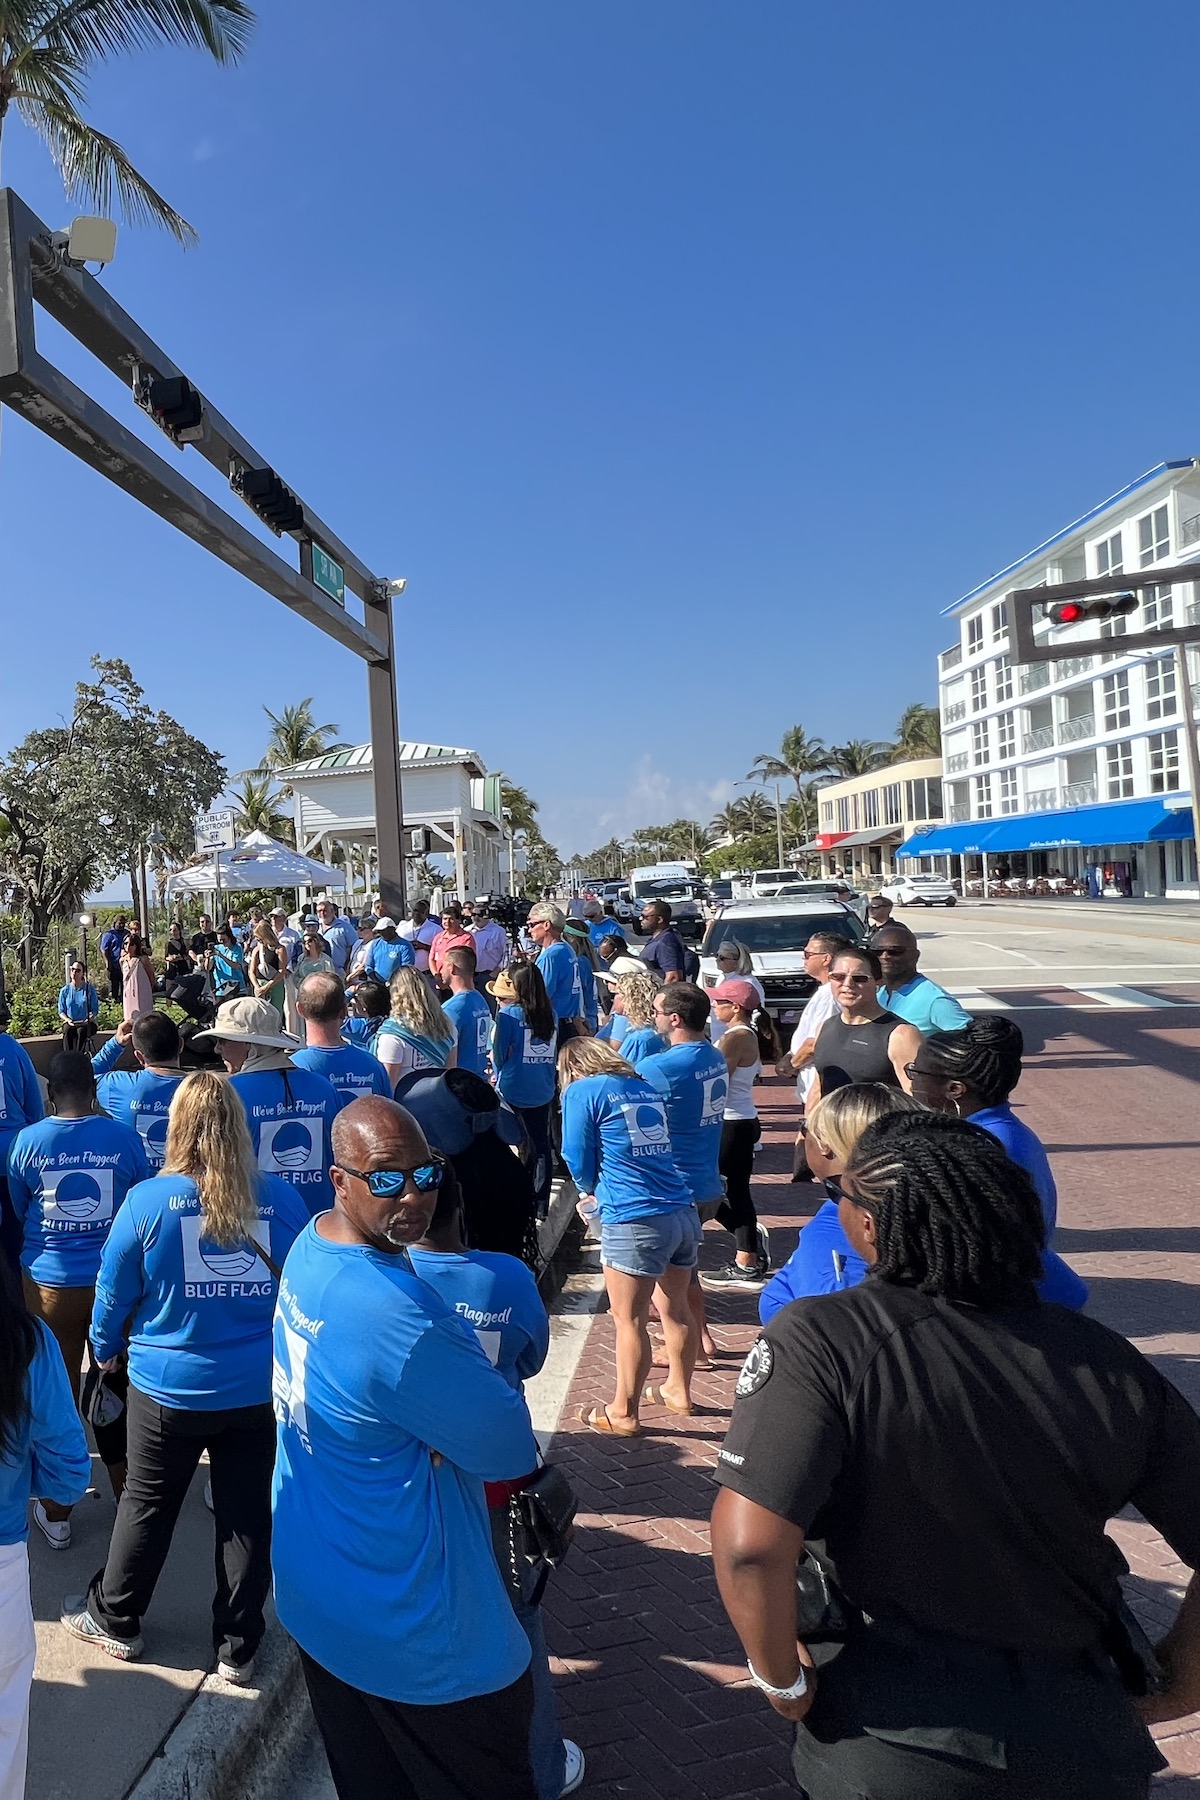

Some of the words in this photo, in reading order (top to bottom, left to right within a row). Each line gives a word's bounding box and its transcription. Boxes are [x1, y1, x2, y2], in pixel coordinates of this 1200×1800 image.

[197, 820, 231, 832] RESTROOM
[198, 813, 228, 824] PUBLIC
[130, 1099, 151, 1111] We've
[153, 1100, 170, 1112] Bee
[632, 1145, 657, 1157] BLUE
[657, 1143, 672, 1154] FLA
[57, 1152, 80, 1166] Been
[82, 1150, 121, 1167] Flagged!
[292, 1170, 323, 1184] FLAG
[168, 1194, 198, 1210] We've
[185, 1283, 227, 1299] BLUE
[230, 1282, 272, 1298] FLAG
[455, 1302, 512, 1327] Flagged!
[757, 1338, 771, 1374] BEACH
